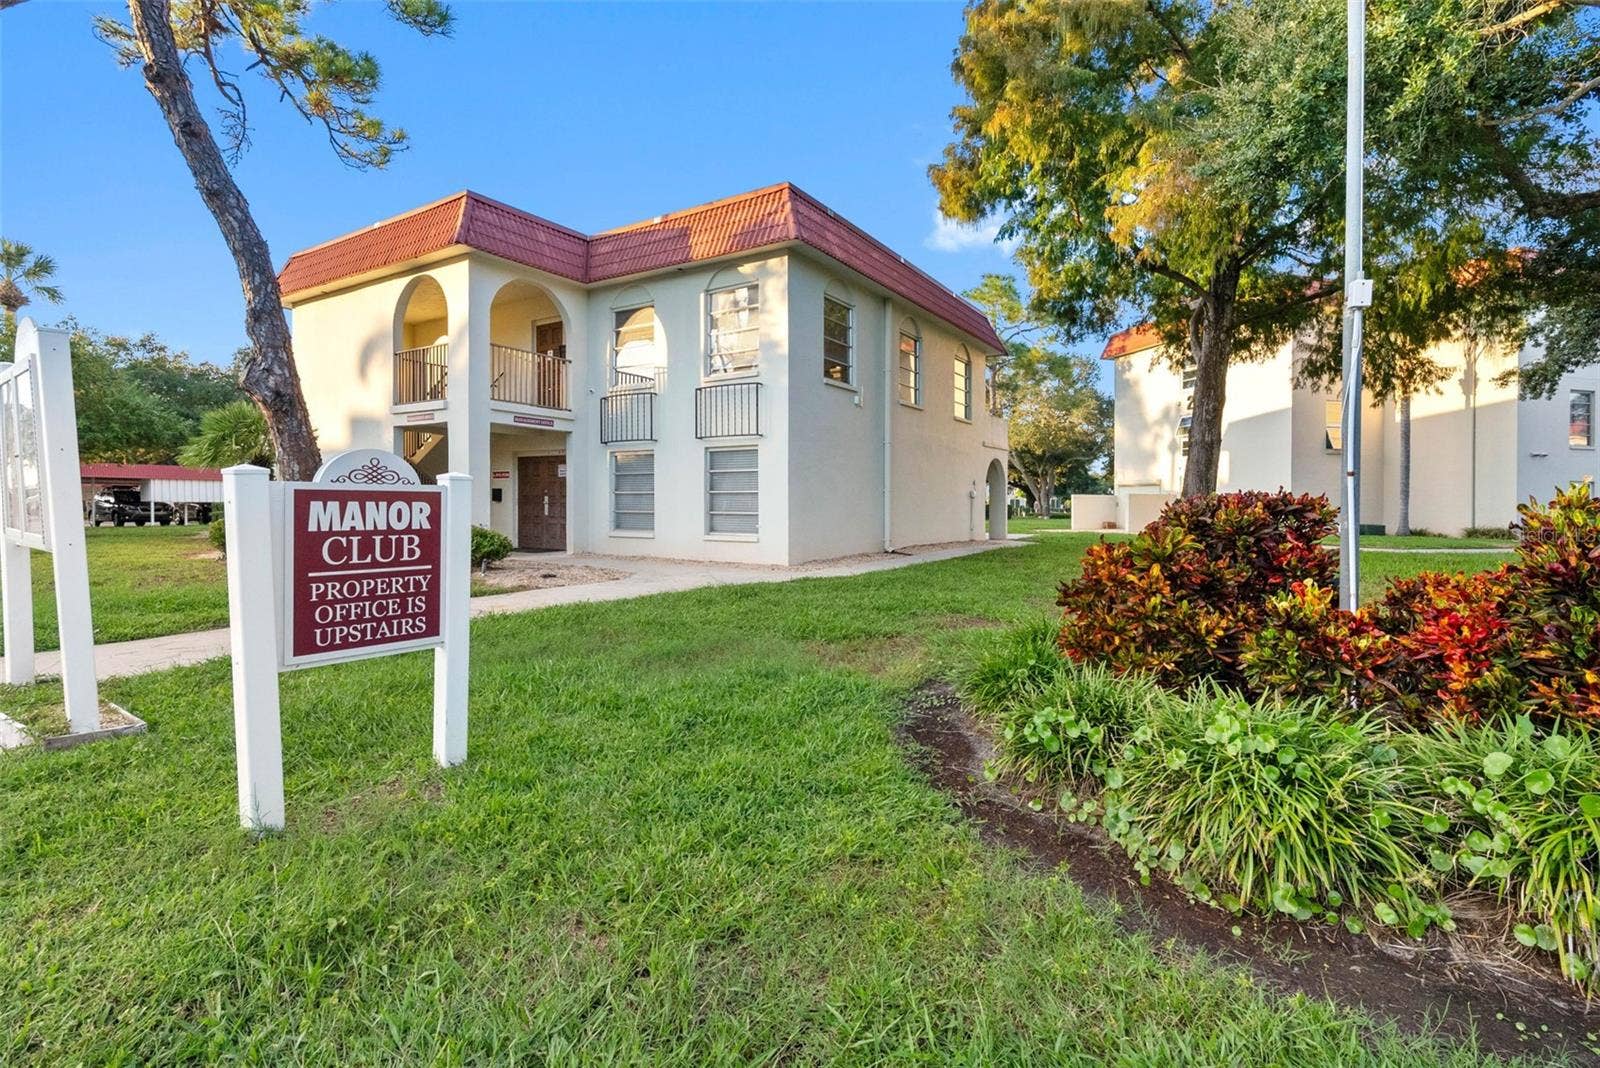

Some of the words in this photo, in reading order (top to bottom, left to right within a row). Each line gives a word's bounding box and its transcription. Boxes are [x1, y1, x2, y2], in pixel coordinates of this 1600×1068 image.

[308, 500, 431, 532] MANOR
[322, 534, 421, 565] CLUB
[310, 574, 432, 602] PROPERTY
[315, 599, 401, 624] OFFICE
[406, 596, 427, 614] IS
[314, 617, 427, 647] UPSTAIRS
